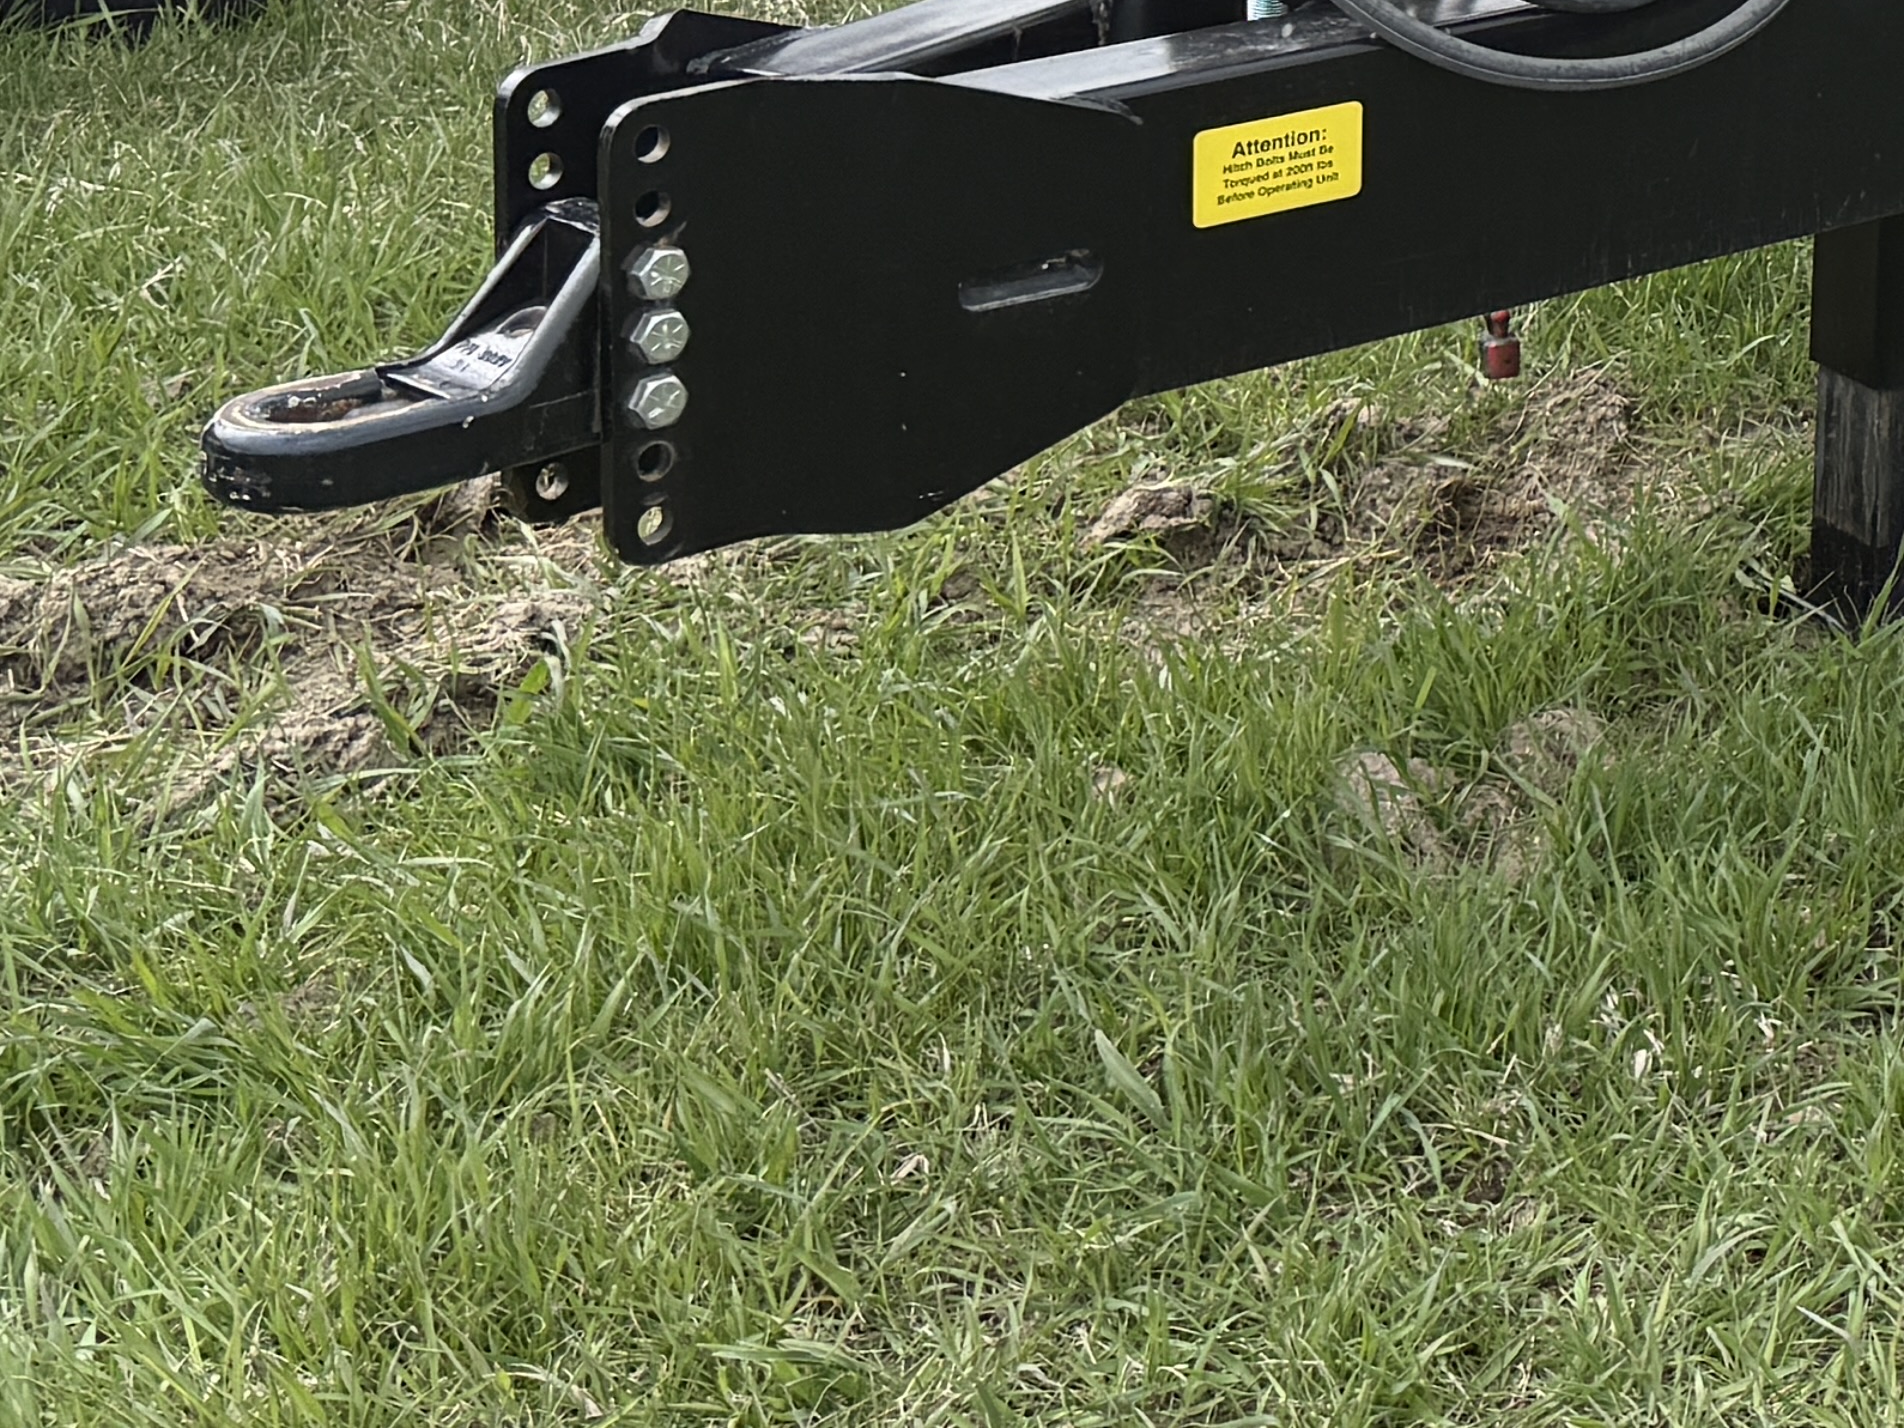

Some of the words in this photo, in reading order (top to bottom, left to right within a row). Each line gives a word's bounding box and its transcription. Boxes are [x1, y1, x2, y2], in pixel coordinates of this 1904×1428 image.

[1231, 128, 1327, 159] Attention:
[1288, 148, 1316, 161] Must
[1319, 144, 1334, 155] Be
[1217, 190, 1255, 206] Before
[1257, 178, 1313, 197] Operating
[1316, 172, 1340, 185] Unit
[1222, 171, 1270, 189] Torqued
[1272, 169, 1283, 179] at
